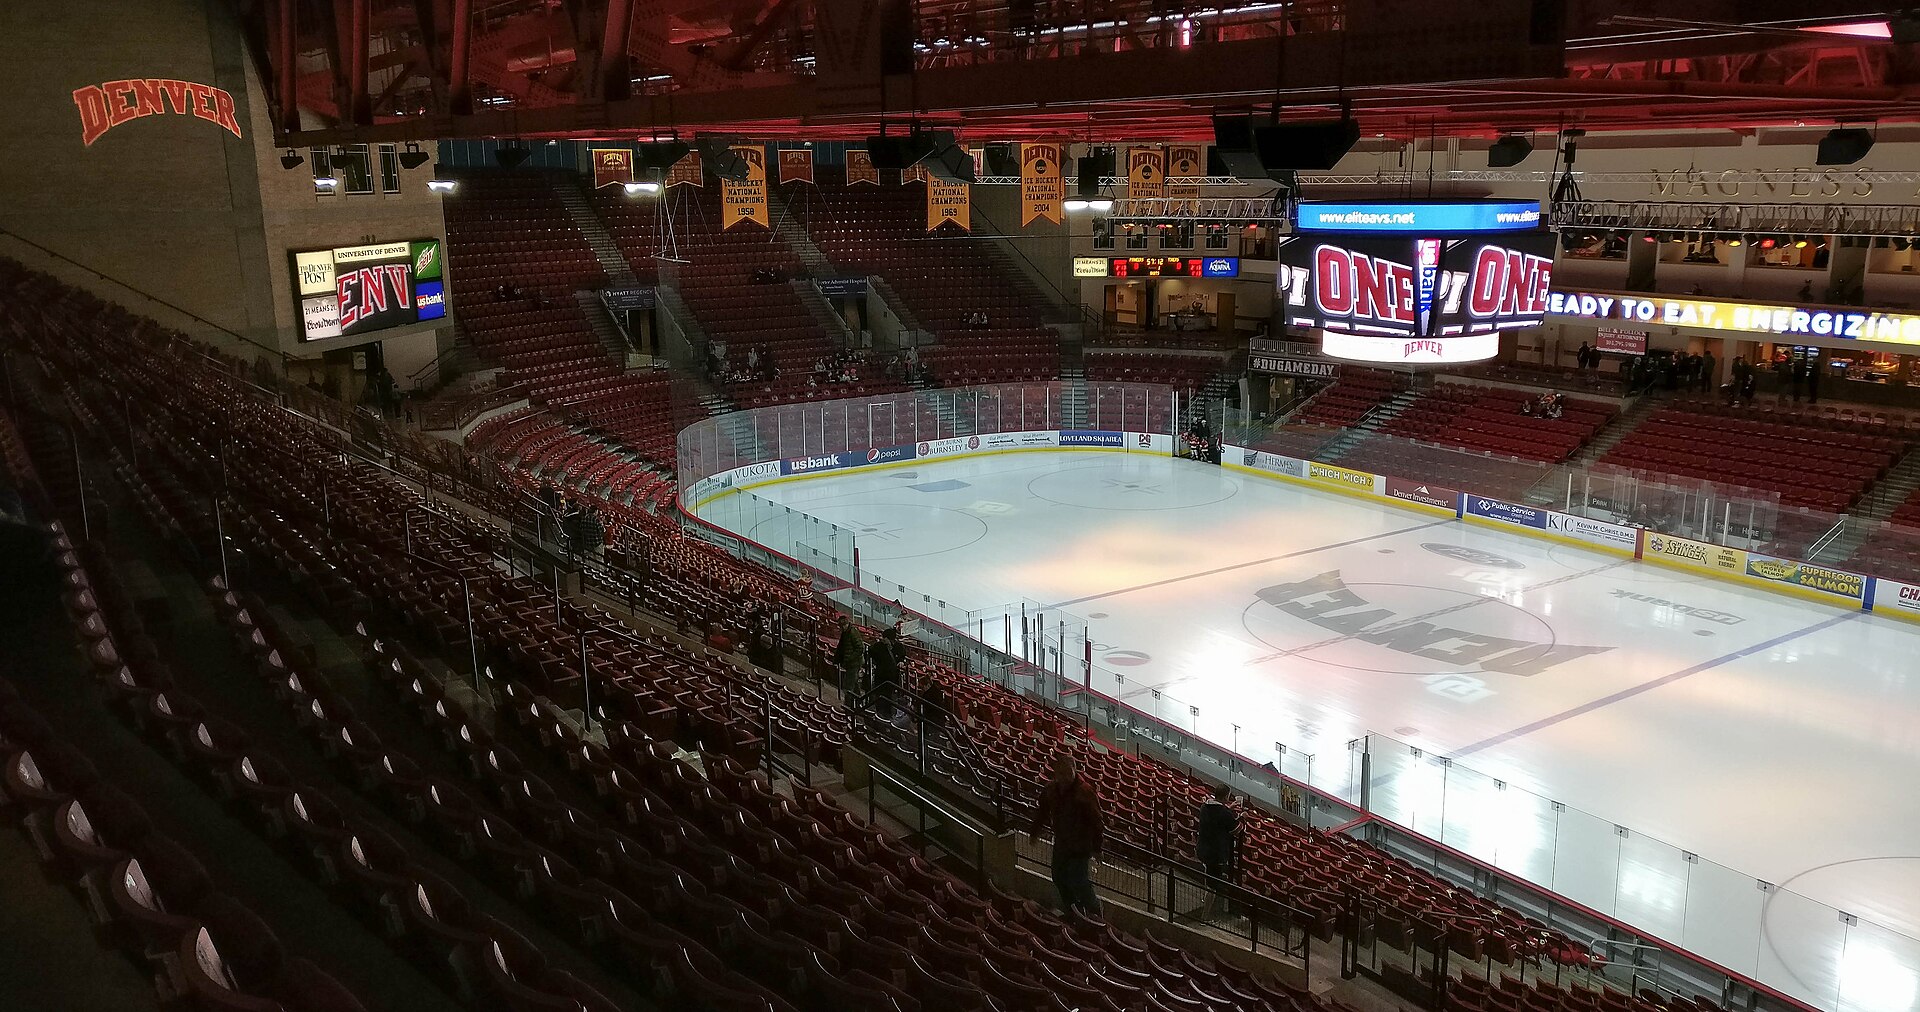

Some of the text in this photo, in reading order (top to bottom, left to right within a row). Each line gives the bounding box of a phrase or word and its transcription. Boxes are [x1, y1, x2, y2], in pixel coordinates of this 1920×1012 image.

[73, 79, 242, 146] DENVER
[1024, 145, 1057, 168] DENVER
[1132, 152, 1162, 175] DENVER
[1650, 166, 1874, 197] MAGNESS
[729, 188, 761, 196] NATIONAL
[737, 207, 755, 216] 1958
[941, 208, 958, 217] 1969
[1033, 203, 1050, 212] 2004
[1319, 211, 1415, 224] www.eliteavs.net
[338, 249, 374, 259] UNIVERSITY
[384, 246, 406, 255] DENVER
[308, 263, 333, 273] DENVER
[304, 271, 327, 285] POST
[1420, 240, 1438, 313] usbank
[1470, 245, 1553, 317] ONE
[1316, 244, 1415, 325] ONE
[337, 264, 411, 330] ENV
[417, 293, 443, 307] usbank
[311, 305, 330, 315] MEANS
[1621, 299, 1655, 320] TO
[1664, 303, 1723, 329] EAT,
[1404, 340, 1442, 358] DENVER
[1253, 358, 1335, 376] #DUGAMEDAY
[880, 448, 901, 459] pepsi
[929, 444, 963, 455] BURNSLEY
[791, 453, 840, 471] usbank
[1264, 455, 1294, 470] HERMES
[734, 463, 778, 479] VUKOTA
[1311, 466, 1341, 480] WHICH
[1393, 488, 1449, 507] Denver Investments
[1592, 498, 1608, 507] PARK
[1492, 501, 1536, 517] Public Service
[1576, 521, 1592, 530] KEVIN
[1665, 540, 1707, 565] STINGER
[1677, 541, 1706, 551] HONEY
[1717, 554, 1737, 563] NATURAL
[1718, 560, 1736, 569] ENERGY
[1760, 564, 1786, 574] SMOKED
[1761, 568, 1784, 577] SALMON
[1800, 575, 1860, 597] SALMON
[1254, 569, 1619, 677] DENVER
